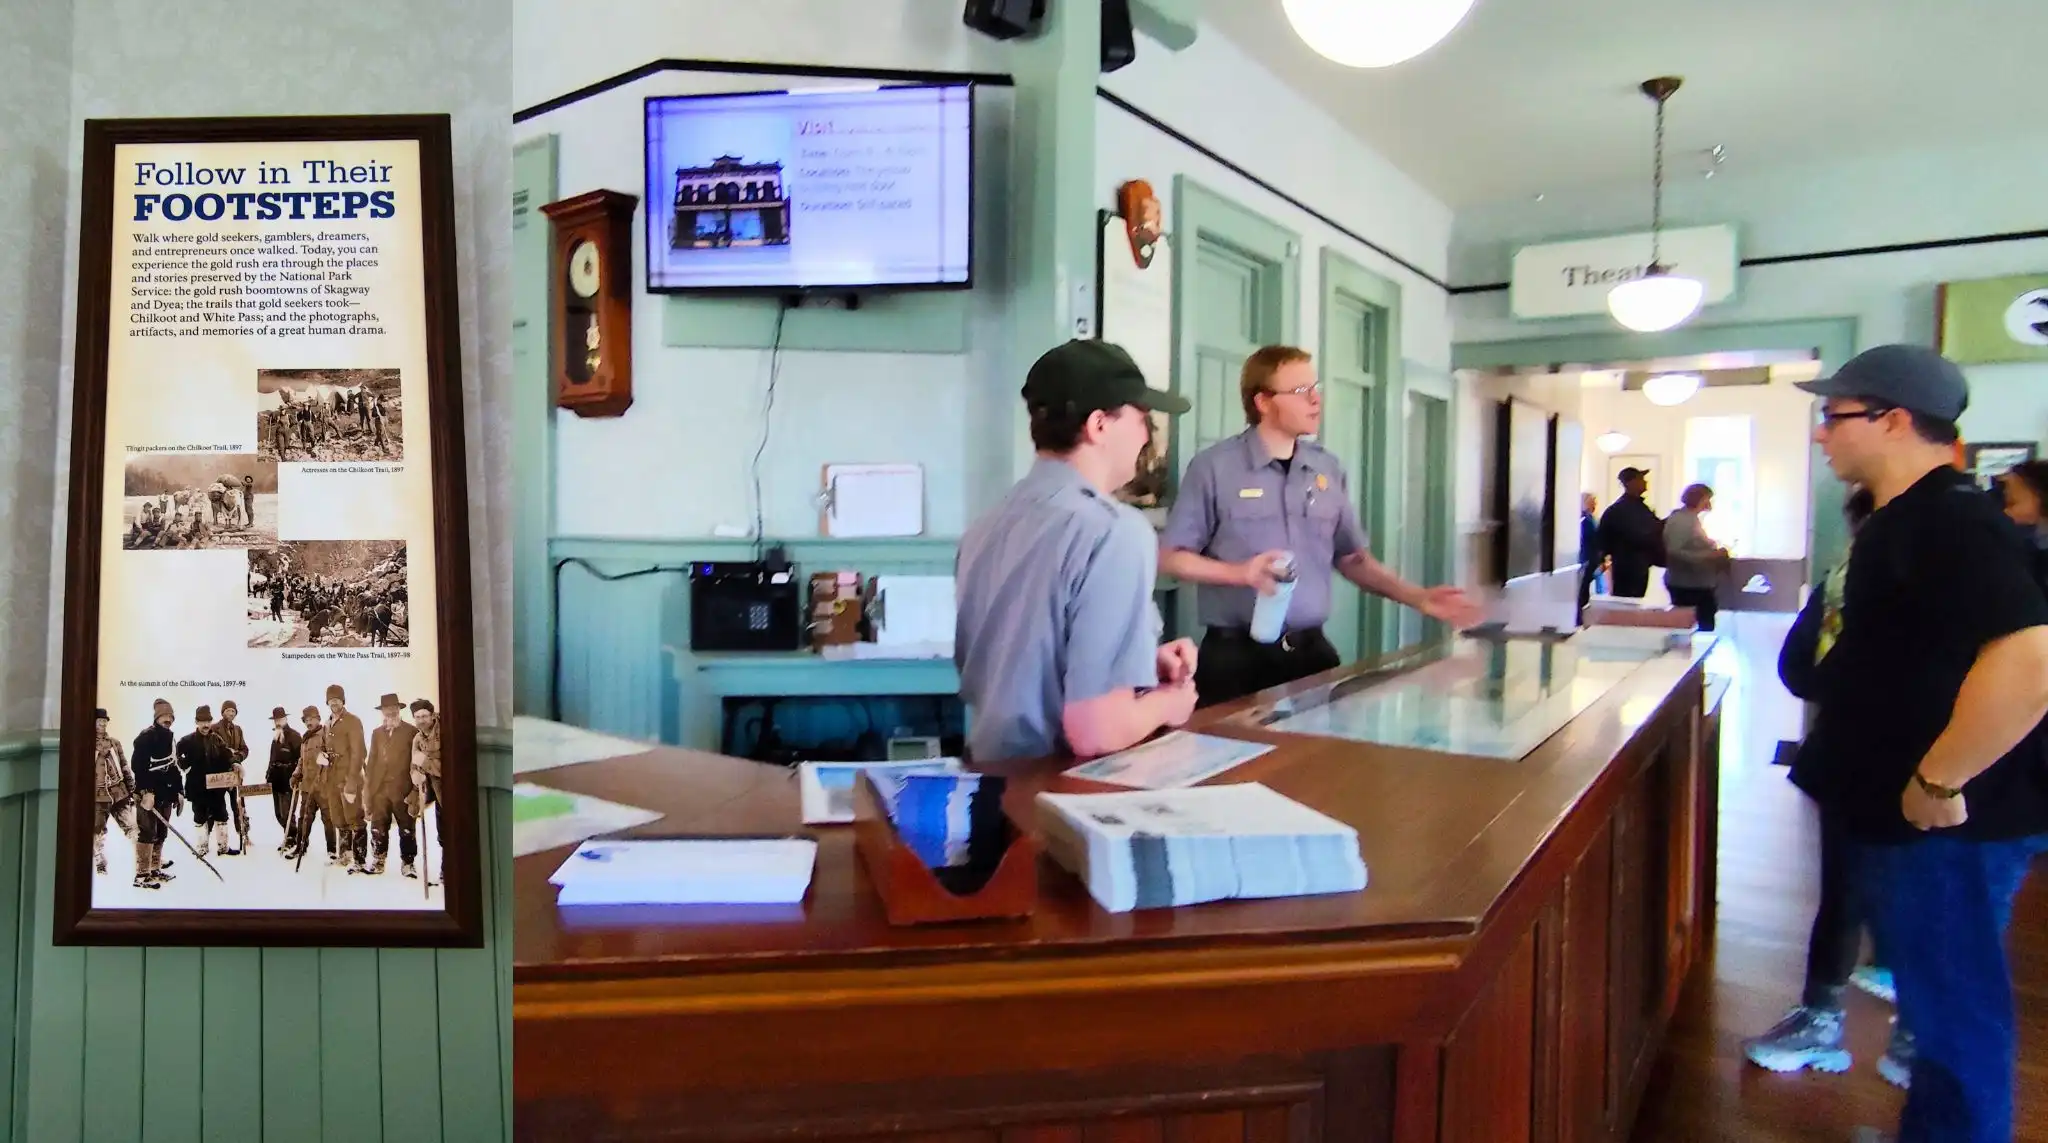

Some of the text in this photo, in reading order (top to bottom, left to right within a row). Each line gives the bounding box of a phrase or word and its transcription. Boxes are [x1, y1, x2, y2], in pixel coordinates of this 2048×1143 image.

[134, 159, 393, 186] Follow in Their
[133, 191, 395, 221] FOOTSTEPS
[132, 231, 369, 245] Walk where gold seekers, gamblers, dreamers,
[132, 247, 152, 256] and
[155, 244, 227, 258] entrepreneurs
[257, 244, 298, 255] walked.
[301, 245, 335, 256] Today,
[338, 247, 356, 256] you
[132, 258, 188, 271] experience
[191, 259, 208, 268] the
[210, 259, 233, 271] gold
[236, 259, 259, 268] rush
[281, 258, 324, 270] through
[327, 257, 343, 267] the
[346, 258, 378, 270] places
[132, 270, 352, 284] and stories preserved by the National Park
[1561, 262, 1678, 288] Theat
[131, 284, 370, 298] Service: the gold rush boomtowns of Skagway
[131, 300, 150, 310] and
[154, 300, 183, 311] Dyea;
[186, 298, 203, 309] the
[206, 299, 232, 308] trails
[236, 299, 256, 308] that
[258, 298, 282, 310] gold
[284, 298, 323, 308] seekers
[130, 311, 379, 324] Chilkoot and White Pass; and the photographs,
[130, 327, 176, 337] artifacts,
[179, 326, 199, 336] and
[202, 326, 254, 335] memories
[257, 325, 268, 335] of
[278, 327, 306, 337] great
[308, 324, 346, 335] human
[349, 325, 386, 334] drama.
[282, 652, 316, 660] Stampeders
[355, 652, 369, 660] Pass
